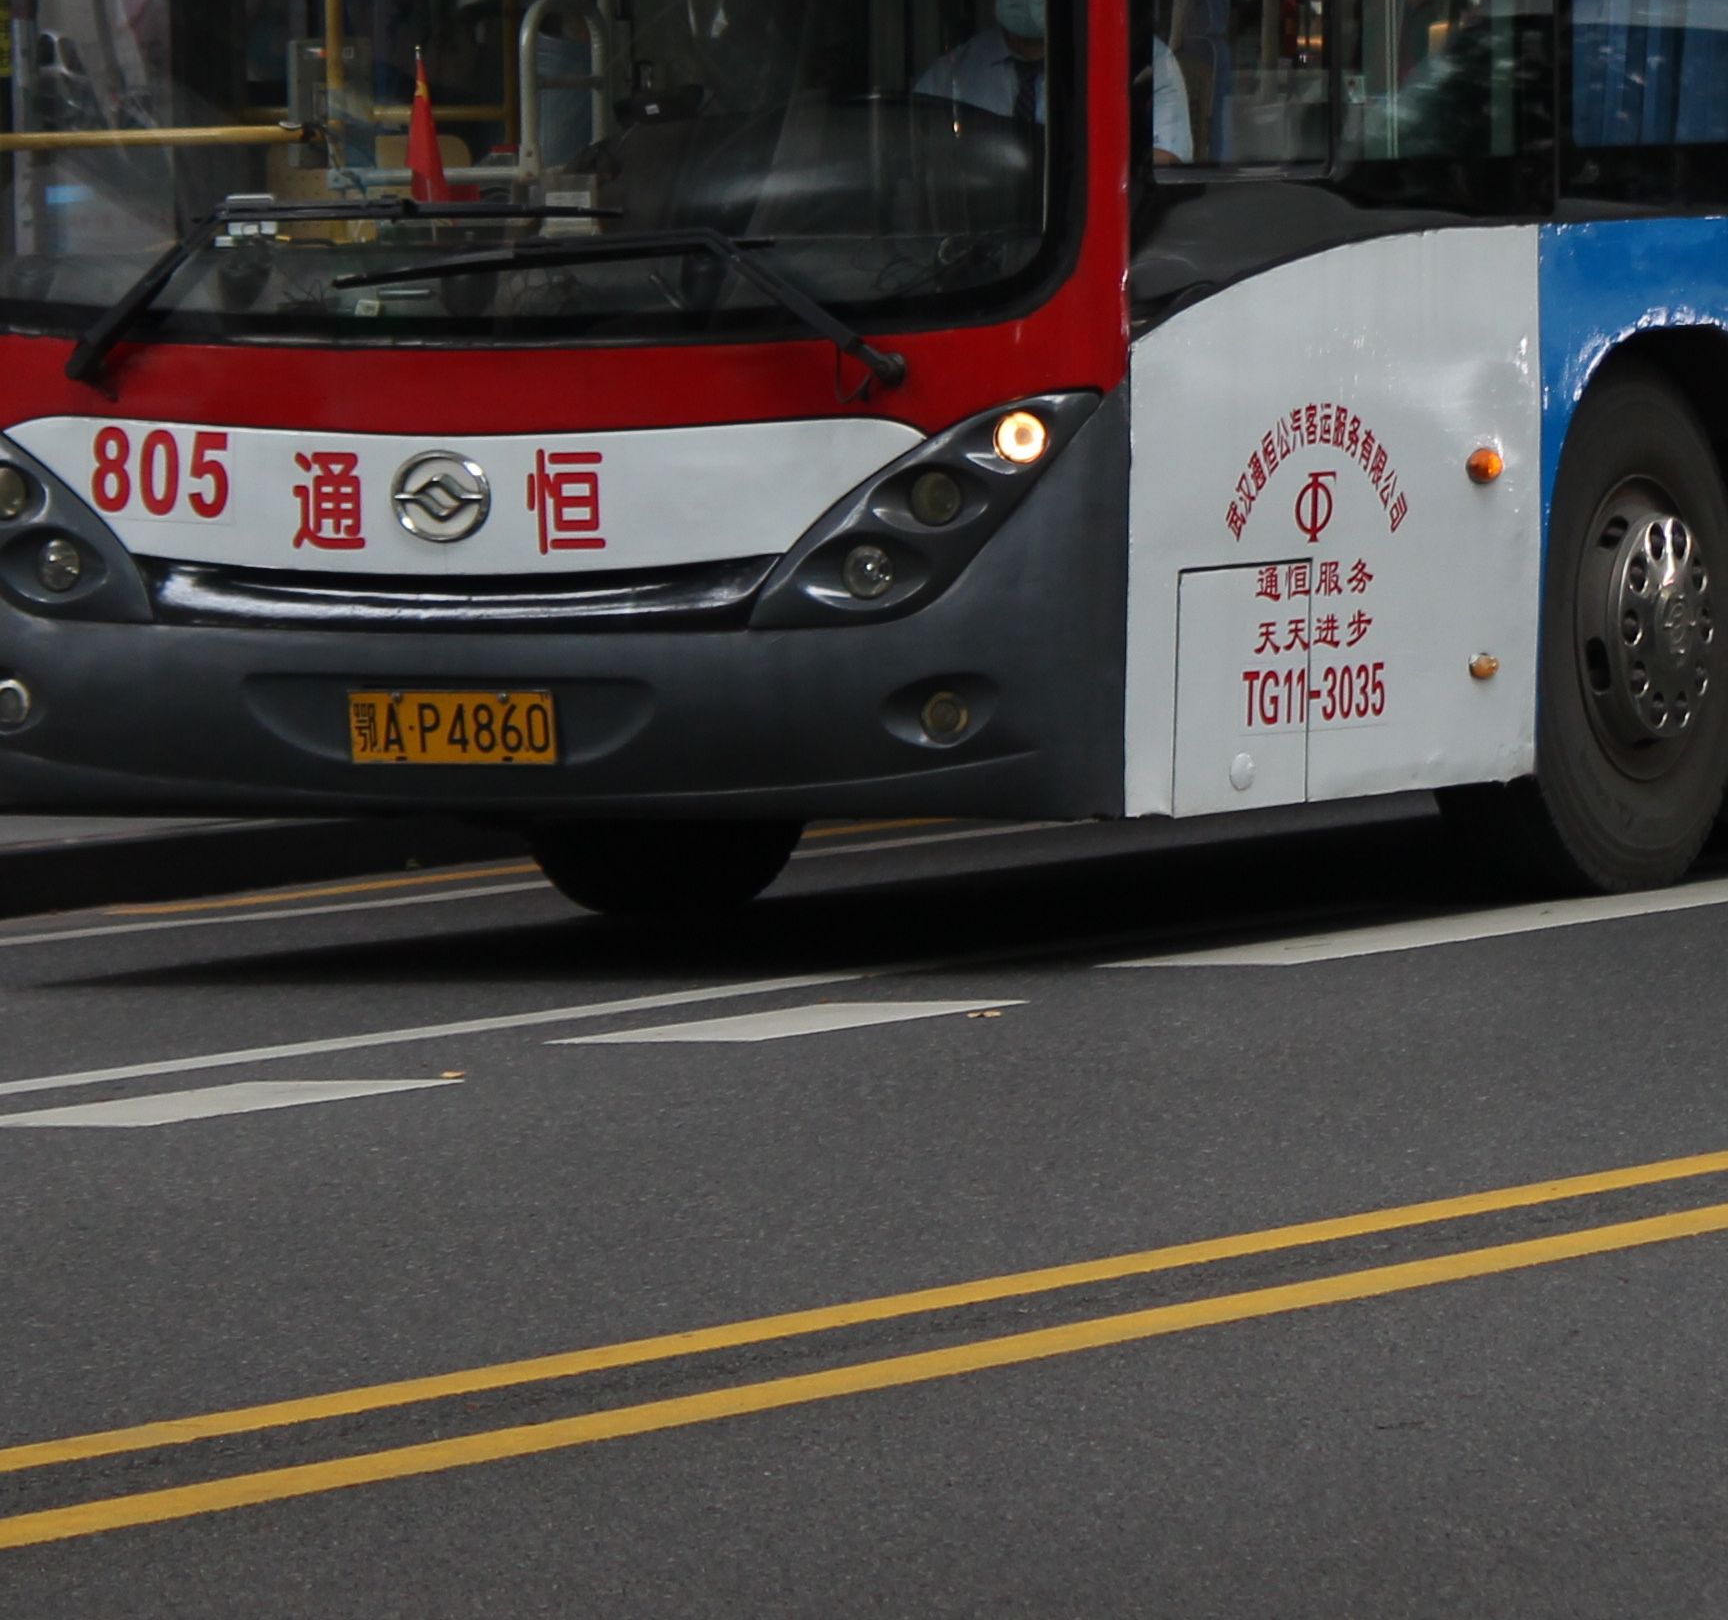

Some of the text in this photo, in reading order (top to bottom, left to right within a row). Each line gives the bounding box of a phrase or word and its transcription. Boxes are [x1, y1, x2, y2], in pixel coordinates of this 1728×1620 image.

[90, 425, 229, 519] 805
[292, 448, 606, 555] 通 恒
[1225, 402, 1408, 543] 武汉通恒公汽客运服务有限公司
[1255, 558, 1374, 602] 通恒服务
[1253, 608, 1373, 655] 天天进步
[1242, 662, 1385, 727] TG11-3035
